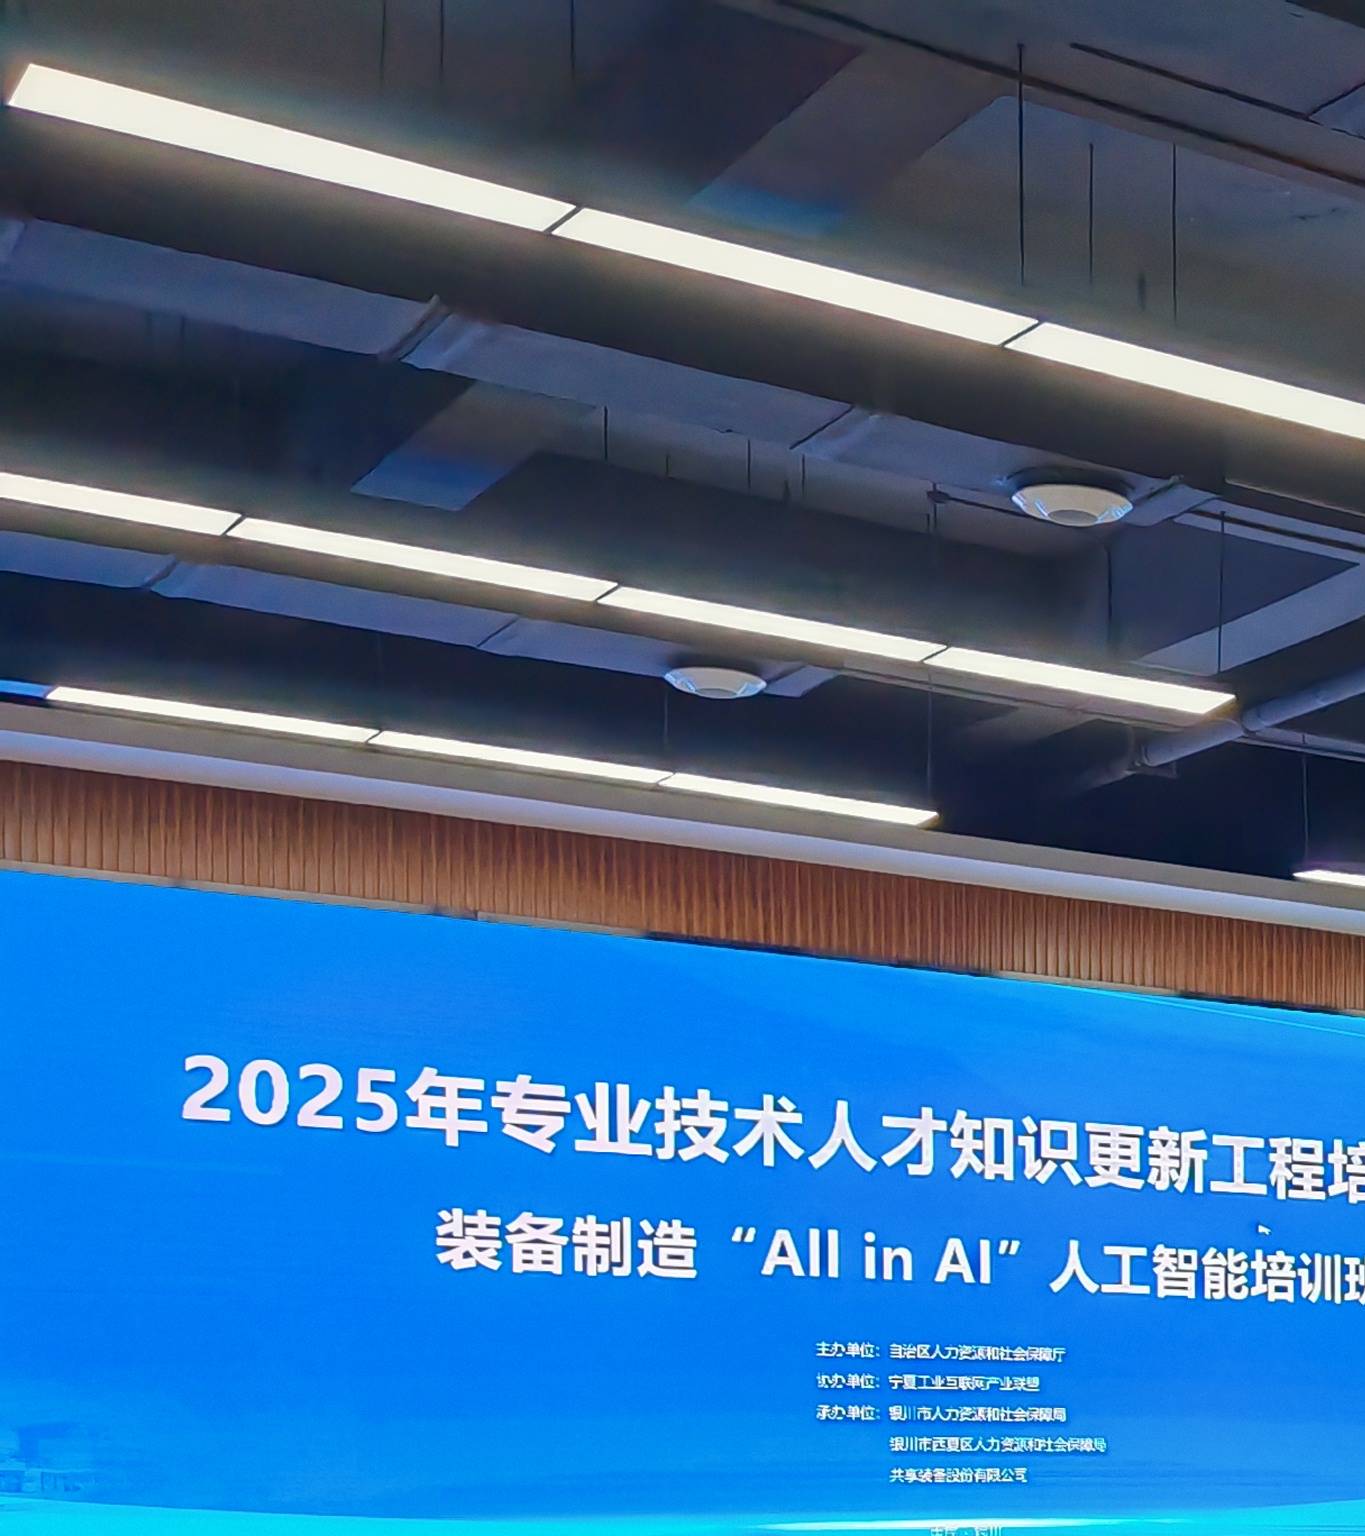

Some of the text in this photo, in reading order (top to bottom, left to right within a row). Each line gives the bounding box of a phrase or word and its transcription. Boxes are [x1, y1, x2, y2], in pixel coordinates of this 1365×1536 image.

[435, 1207, 697, 1280] 装备制造
[864, 1231, 913, 1282] in
